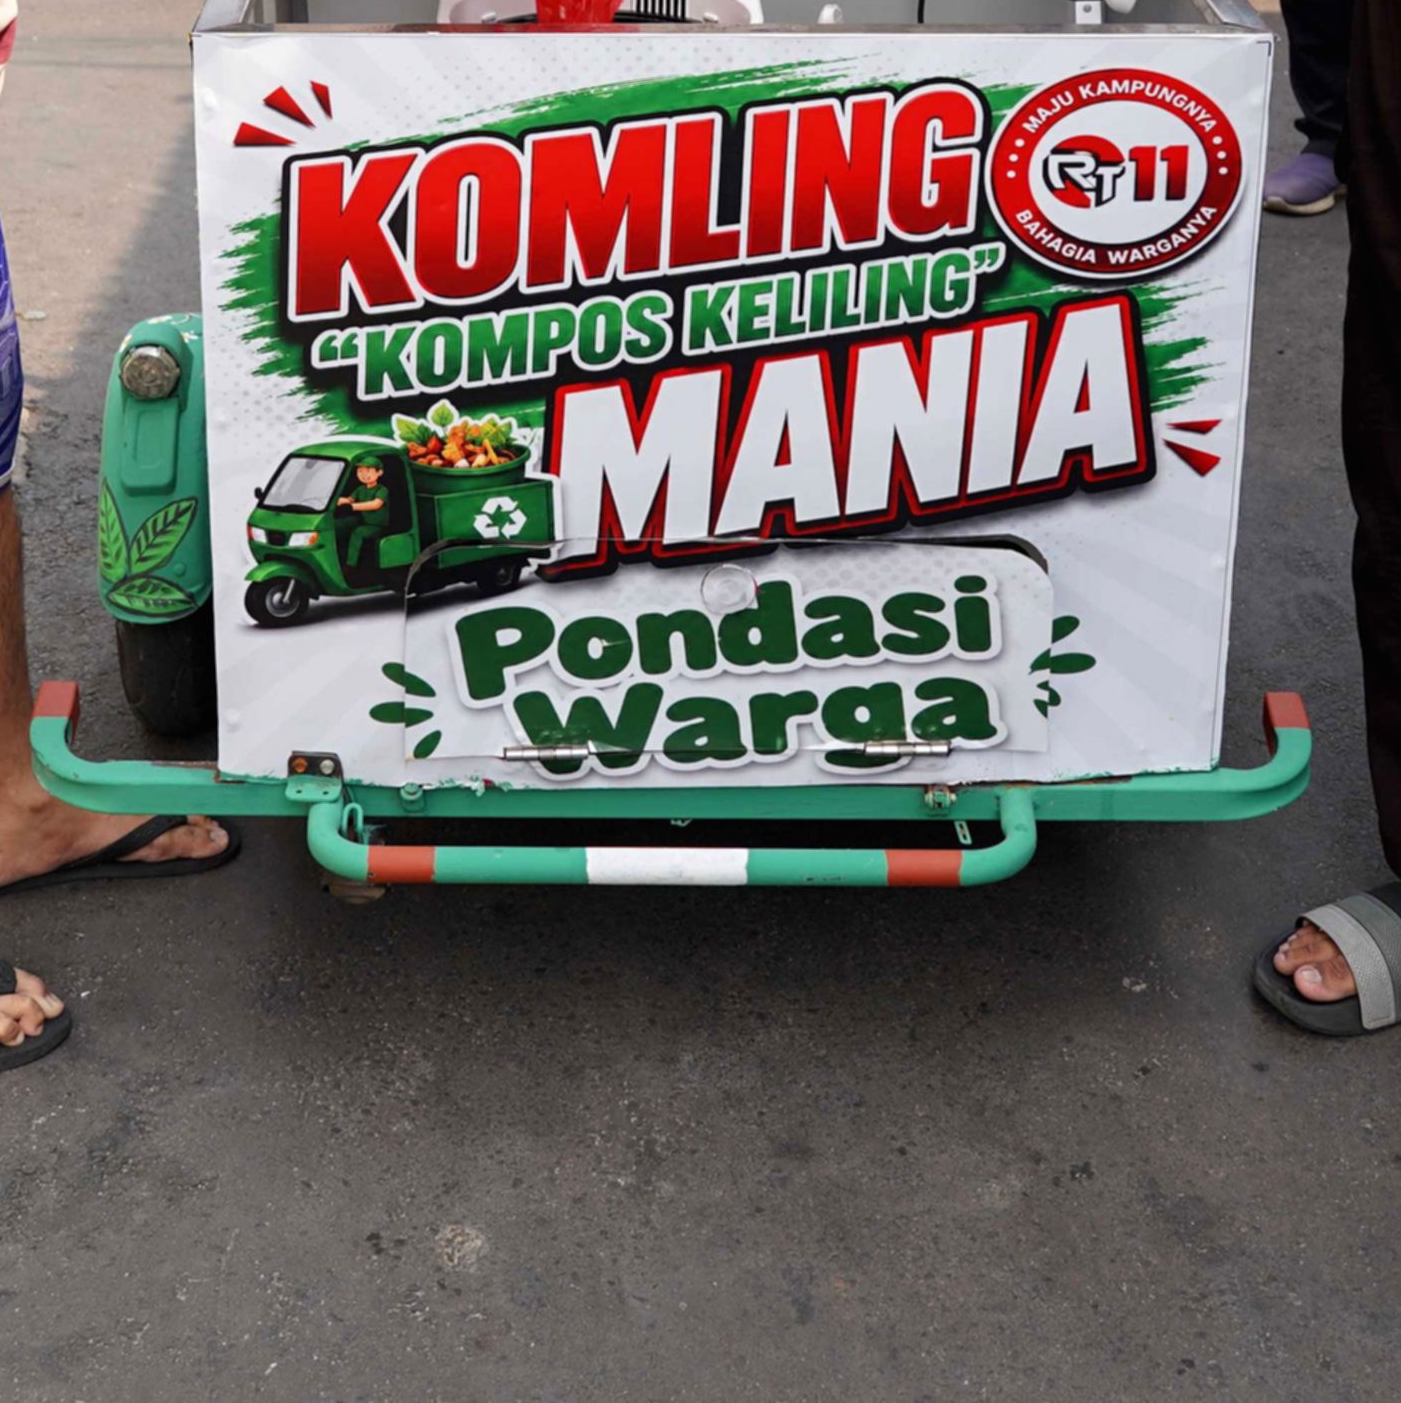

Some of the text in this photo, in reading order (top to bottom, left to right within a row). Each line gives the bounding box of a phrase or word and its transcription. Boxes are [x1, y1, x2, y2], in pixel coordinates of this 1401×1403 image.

[1022, 80, 1218, 133] MAJU KAMPUNGNYA
[290, 87, 982, 320] KOMLING
[1016, 206, 1217, 265] BAHAGIA WARGANYA
[558, 301, 1141, 561] MANIA
[455, 576, 991, 700] Pondasi
[513, 676, 996, 768] Warga
